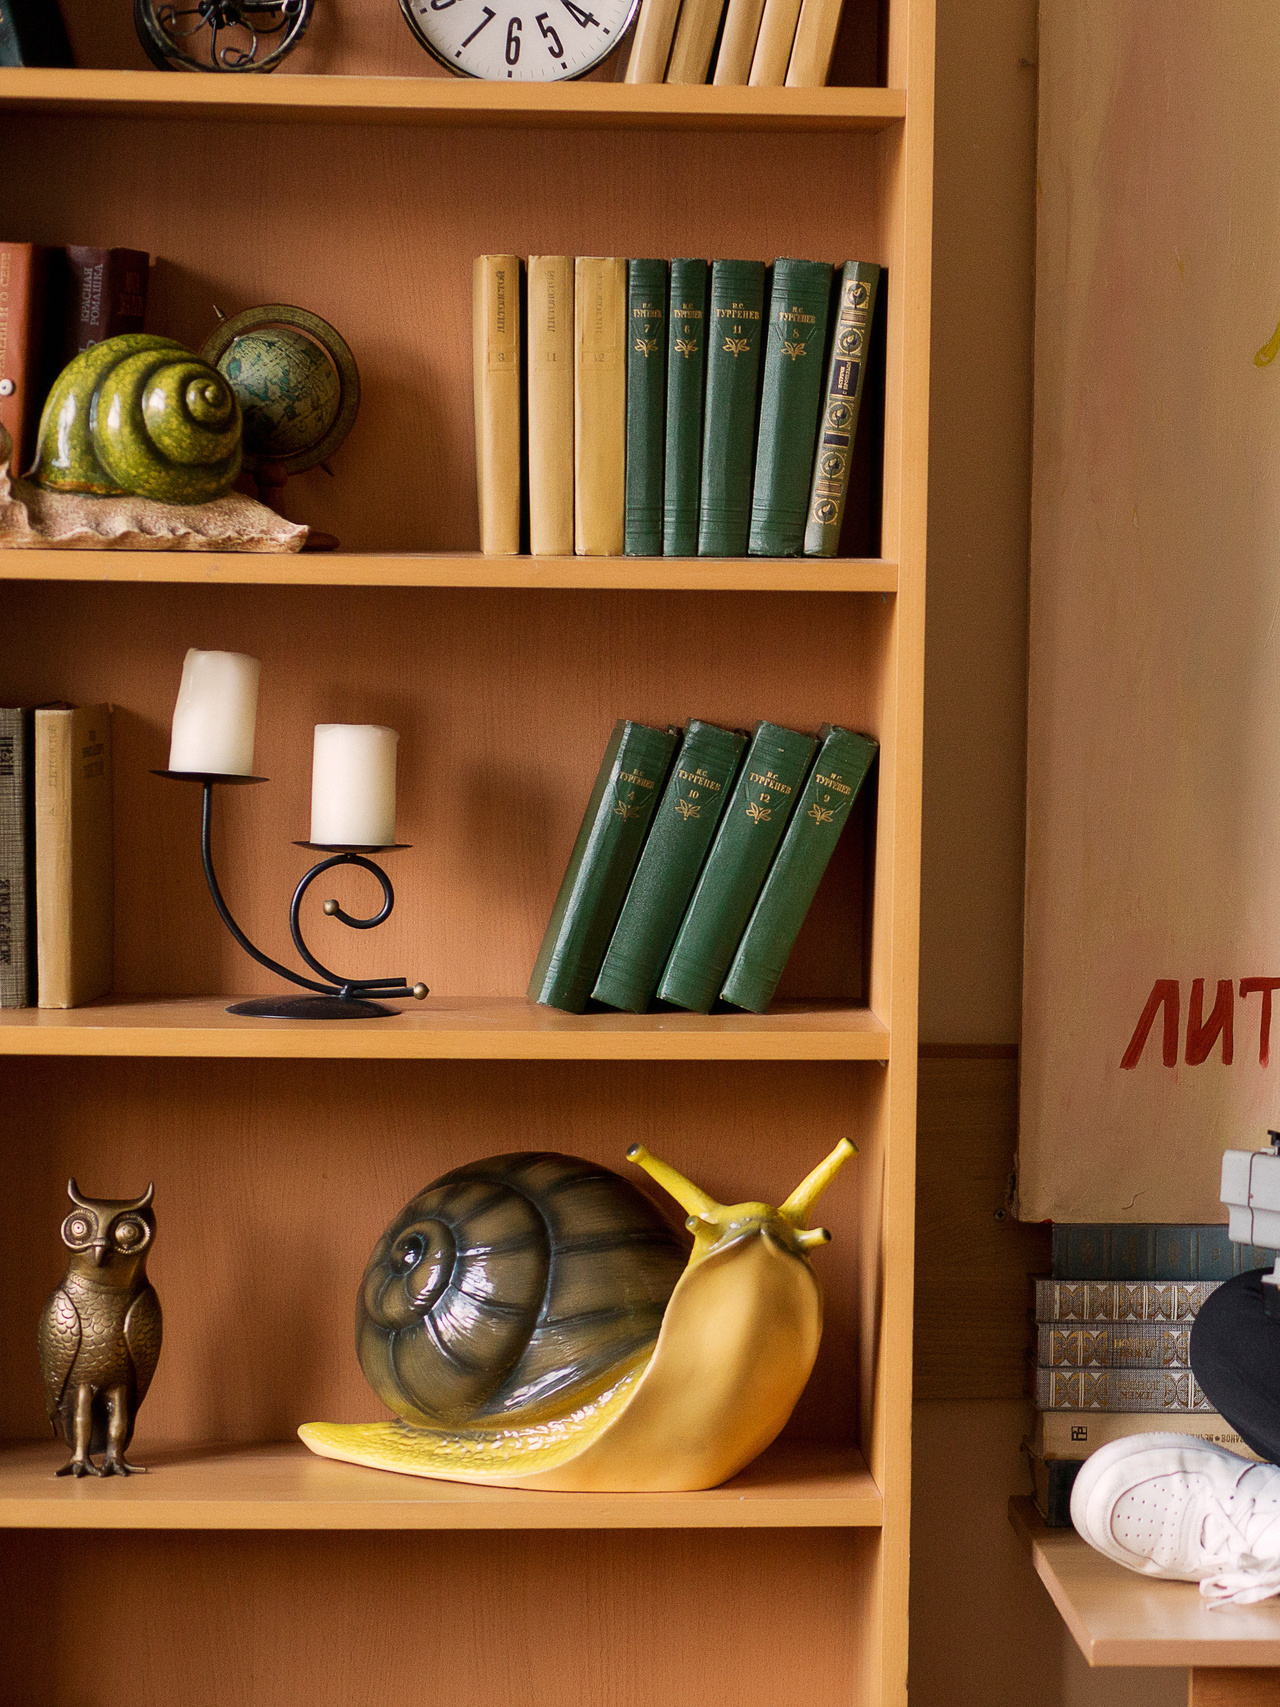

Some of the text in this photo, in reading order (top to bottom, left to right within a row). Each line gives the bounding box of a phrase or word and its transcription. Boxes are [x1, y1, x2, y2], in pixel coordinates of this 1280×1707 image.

[559, 0, 601, 28] 4
[461, 6, 496, 49] 7
[505, 17, 522, 65] 6
[534, 12, 564, 59] 5
[81, 267, 93, 322] КРАСНАЯ
[89, 264, 103, 326] РОМАШКА
[632, 309, 662, 318] ТУРГЕНЕВ
[673, 309, 702, 319] ТУРГЕНЕВ
[716, 309, 761, 320] ТУРГЕНЕВ
[779, 312, 816, 324] ТУРГЕНЕВ
[644, 324, 651, 333] 7
[684, 325, 690, 333] 6
[792, 328, 800, 338] 8
[619, 771, 655, 790] ТУРГЕНЕВ
[678, 769, 721, 792] ТУРГЕНЕВ
[749, 771, 792, 795] ТУРГЕНЕВ
[815, 774, 852, 795] ТУРГЕНЕВ
[627, 790, 635, 800] 4
[688, 789, 699, 799] 10
[759, 792, 770, 803] 12
[823, 793, 831, 803] 9
